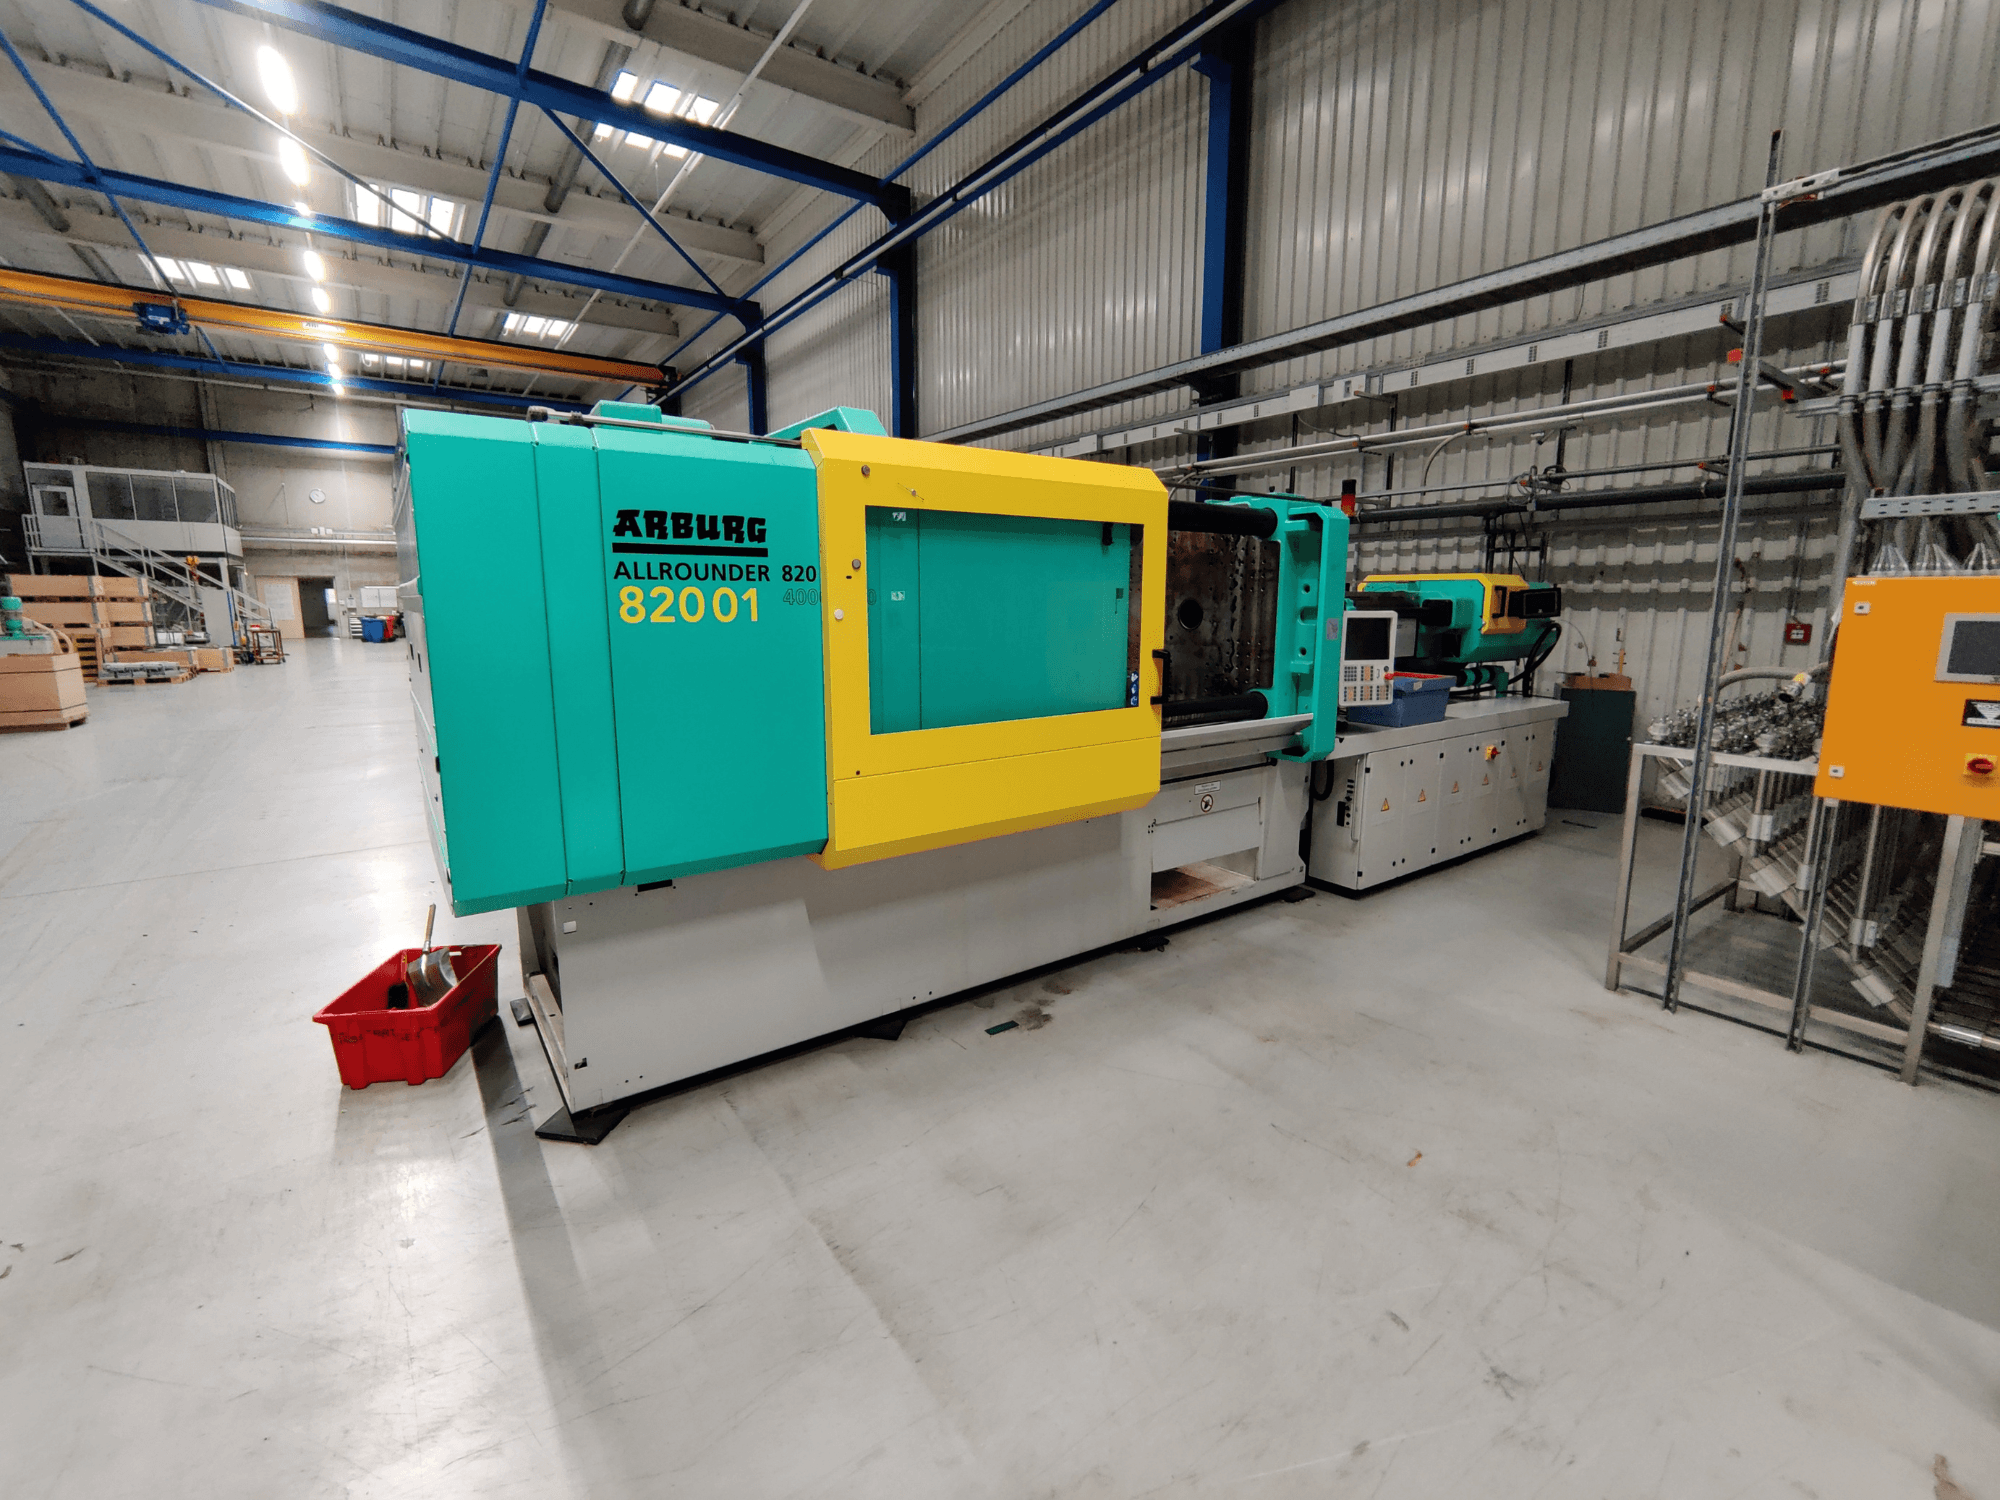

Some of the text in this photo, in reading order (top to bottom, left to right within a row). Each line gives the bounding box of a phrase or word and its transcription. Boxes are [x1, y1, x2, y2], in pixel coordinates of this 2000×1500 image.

[612, 509, 767, 544] ARBURG
[613, 560, 817, 583] ALLROUNDER 820
[782, 588, 821, 606] 400
